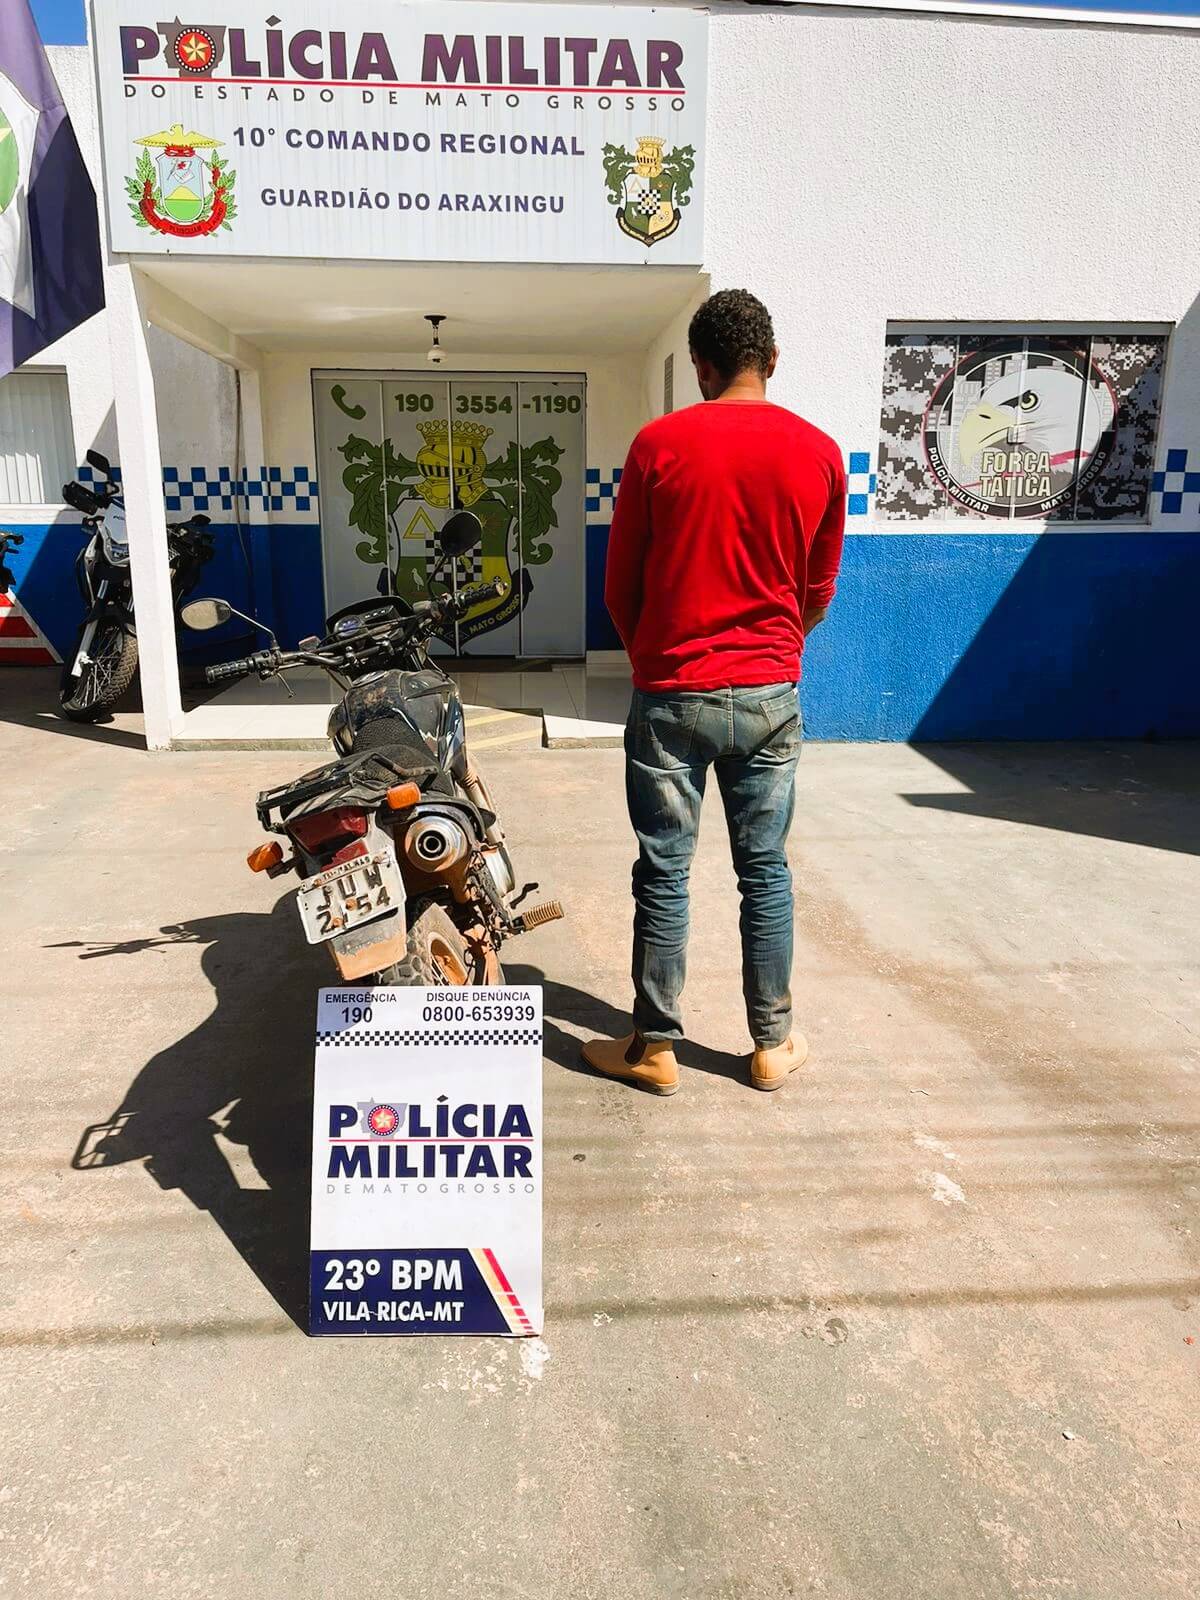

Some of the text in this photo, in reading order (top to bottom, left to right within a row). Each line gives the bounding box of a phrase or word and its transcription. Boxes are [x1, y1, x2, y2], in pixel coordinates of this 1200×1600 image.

[421, 34, 685, 88] MILITAR
[124, 84, 685, 111] DO ESTADO DE MATO GROSSO
[285, 129, 431, 153] COMANDO
[440, 134, 585, 156] REGIONAL
[261, 187, 565, 214] GUARDIÃO DO ARAXINGU
[394, 393, 434, 413] 190
[455, 395, 513, 414] 3554
[948, 486, 990, 513] MILITAR
[1041, 490, 1072, 512] MATO
[469, 617, 496, 634] MATO
[325, 991, 397, 1003] EMERGÊNCIA
[426, 990, 531, 1003] DISQUE DENÚNCIA
[341, 1007, 373, 1023] 190
[422, 1006, 535, 1022] 0800-653939
[327, 1145, 533, 1178] MILITAR
[391, 1259, 464, 1291] BPM
[322, 1301, 465, 1321] VILA RICA-MT
